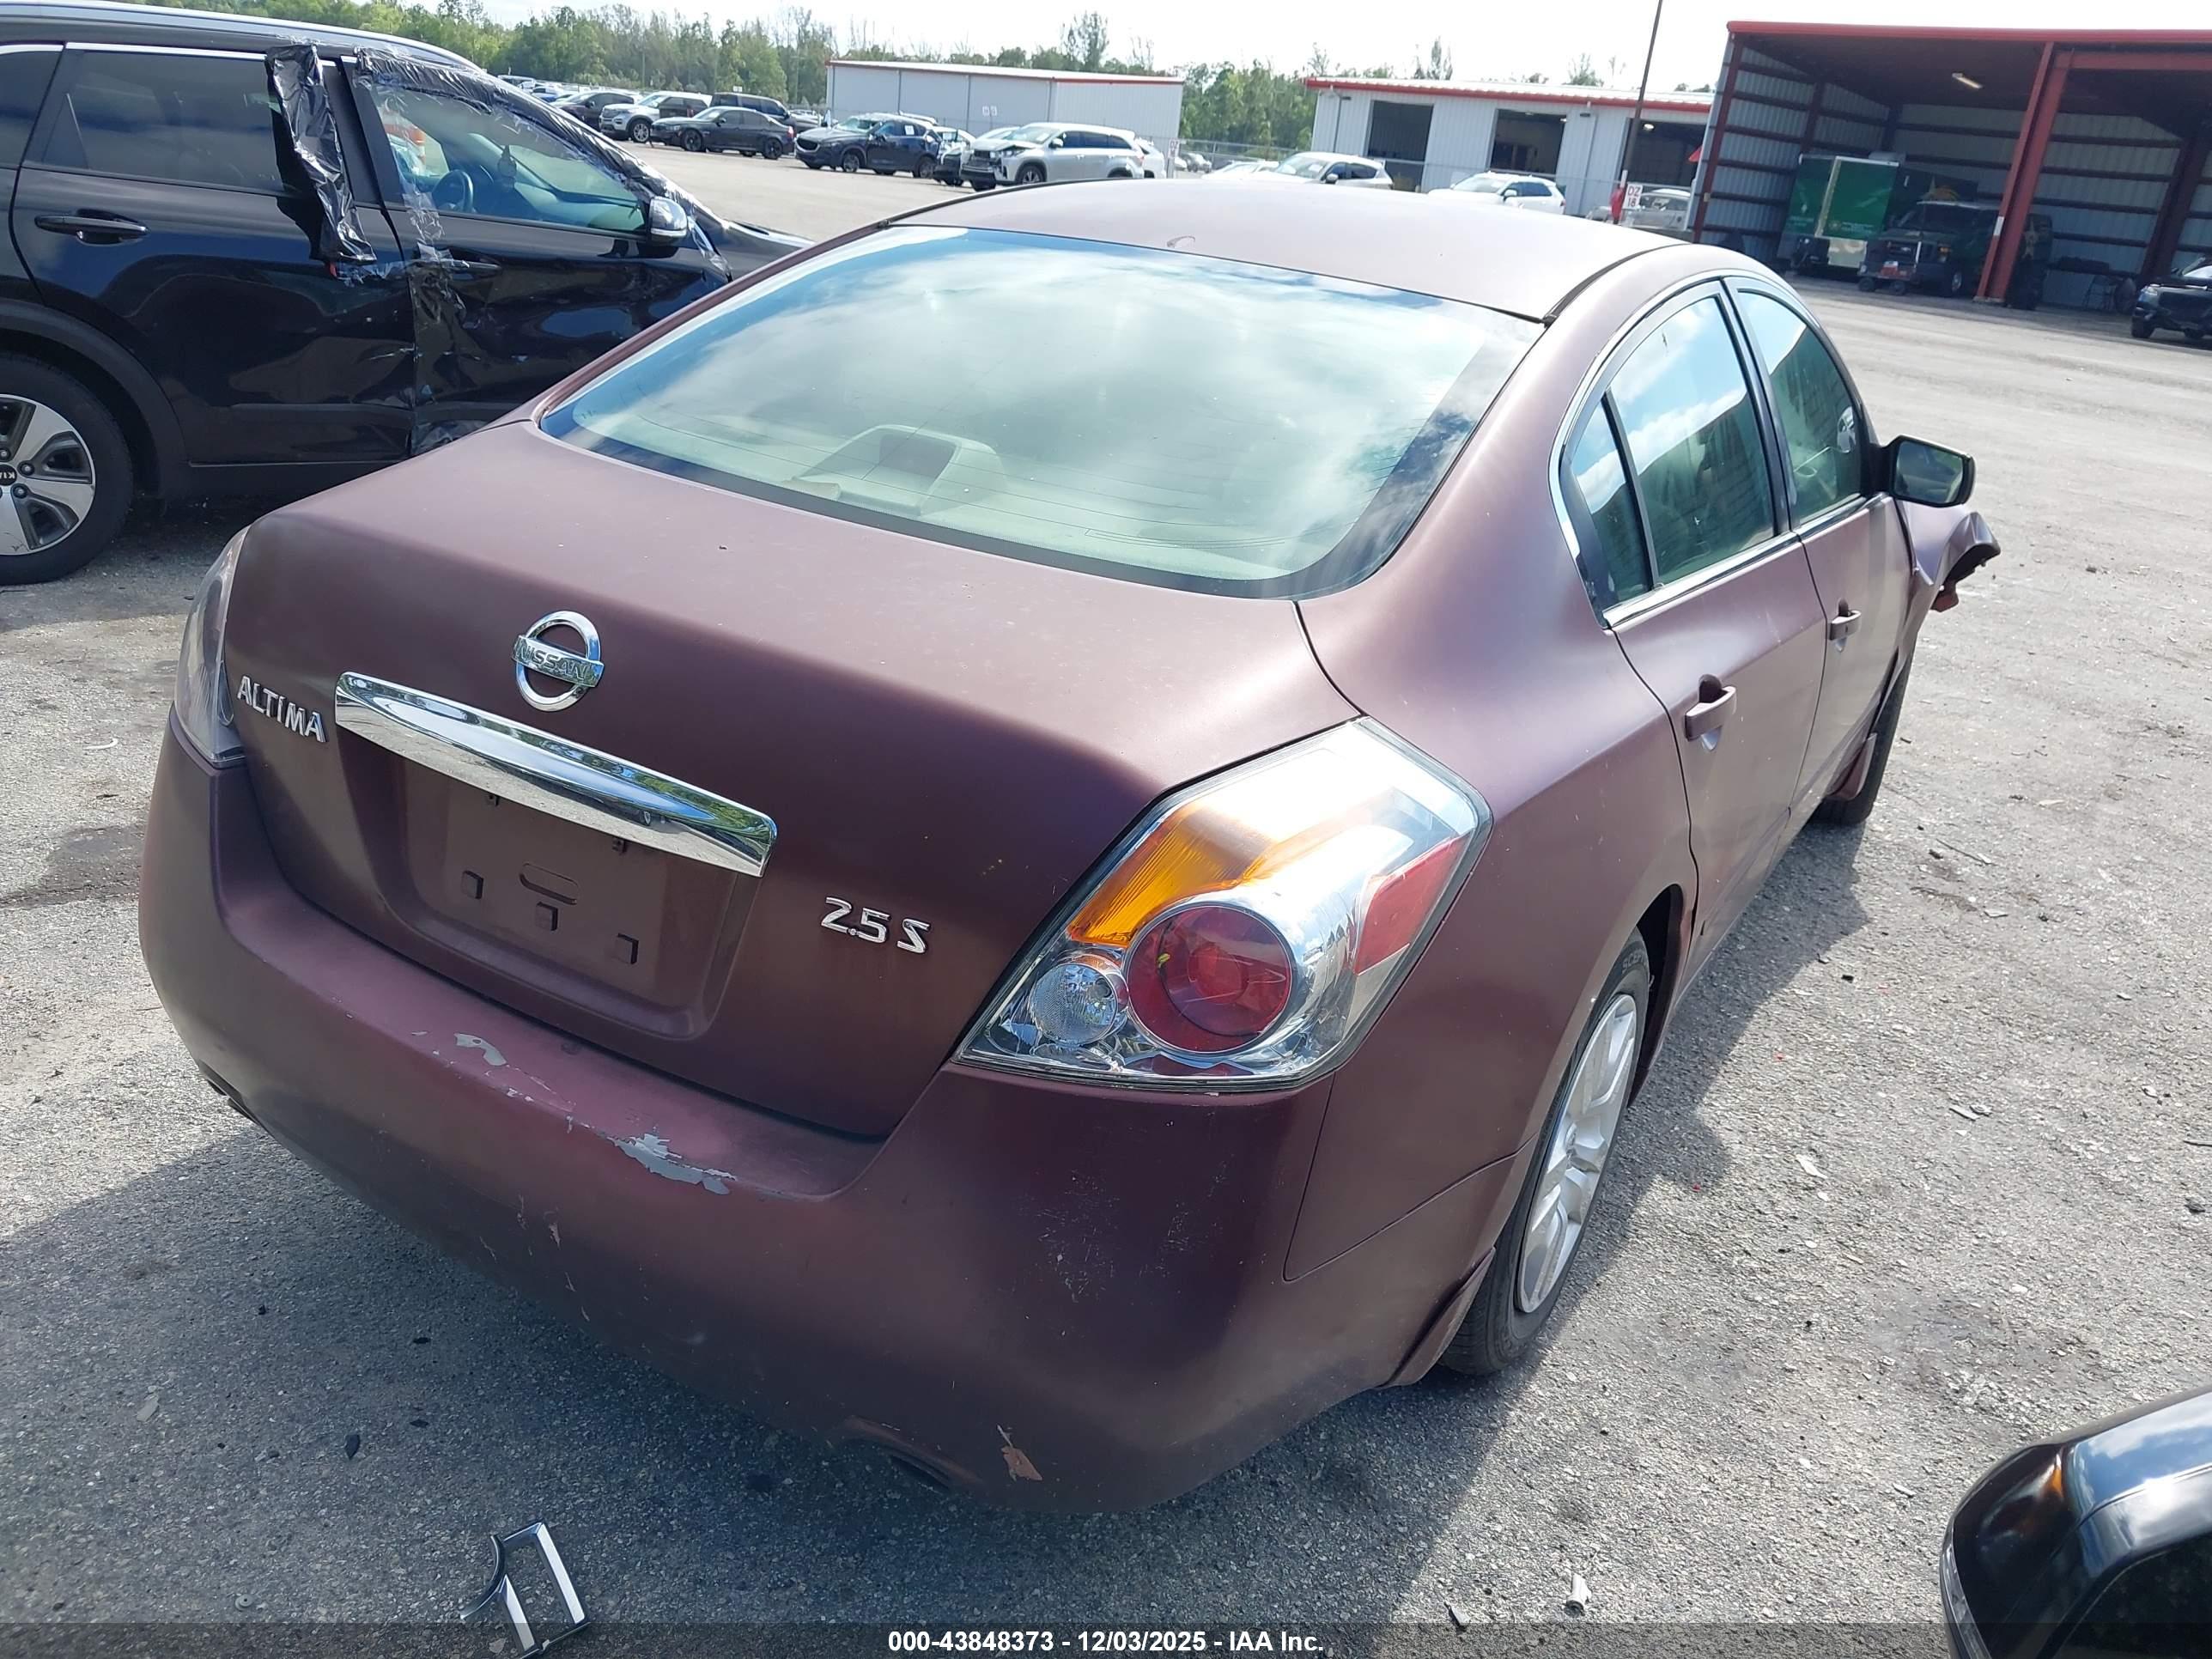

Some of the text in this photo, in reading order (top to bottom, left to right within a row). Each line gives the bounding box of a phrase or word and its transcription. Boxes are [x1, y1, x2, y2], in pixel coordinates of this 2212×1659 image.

[515, 637, 593, 683] NISSAN
[237, 675, 326, 743] ALTIMA
[821, 896, 930, 953] 2.5 S
